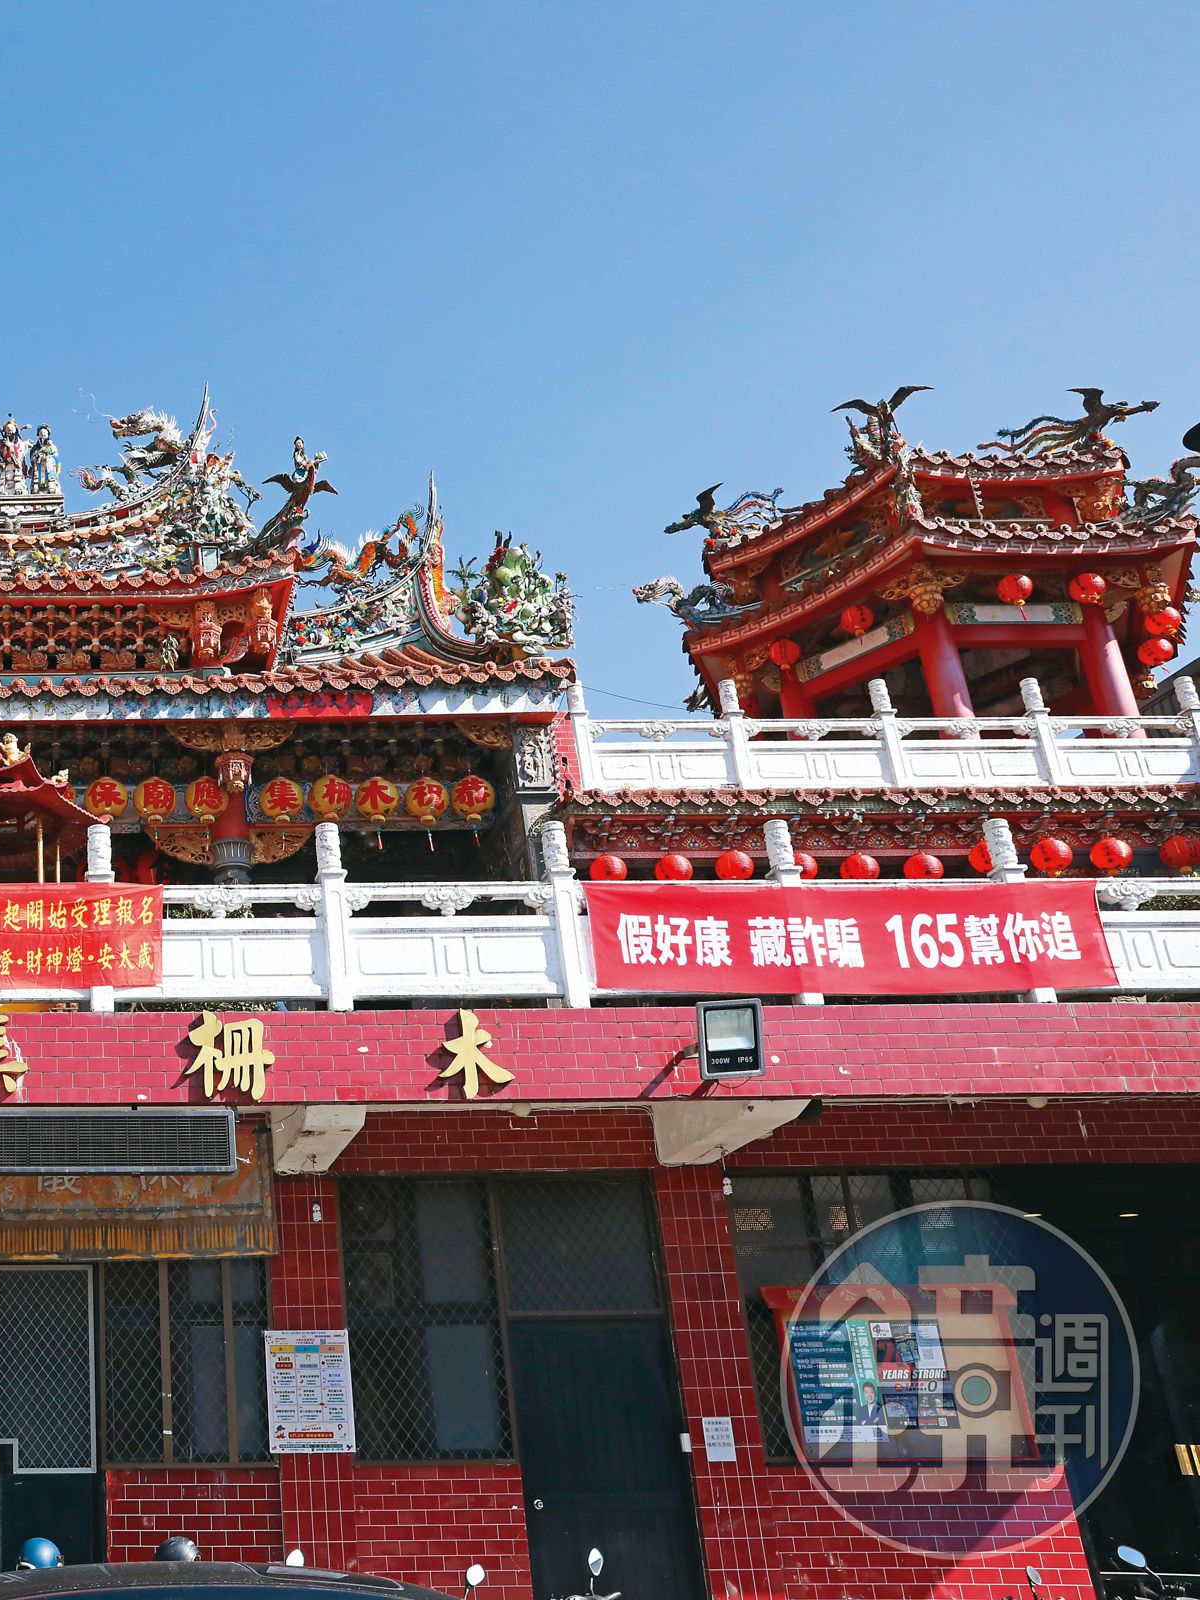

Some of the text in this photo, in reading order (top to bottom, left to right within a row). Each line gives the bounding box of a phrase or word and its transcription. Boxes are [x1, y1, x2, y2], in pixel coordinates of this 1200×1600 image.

[616, 910, 1082, 969] 假好康 藏詐騙 165幫你追
[711, 1057, 730, 1065] 300W
[882, 1369, 947, 1380] YEARS STRONG
